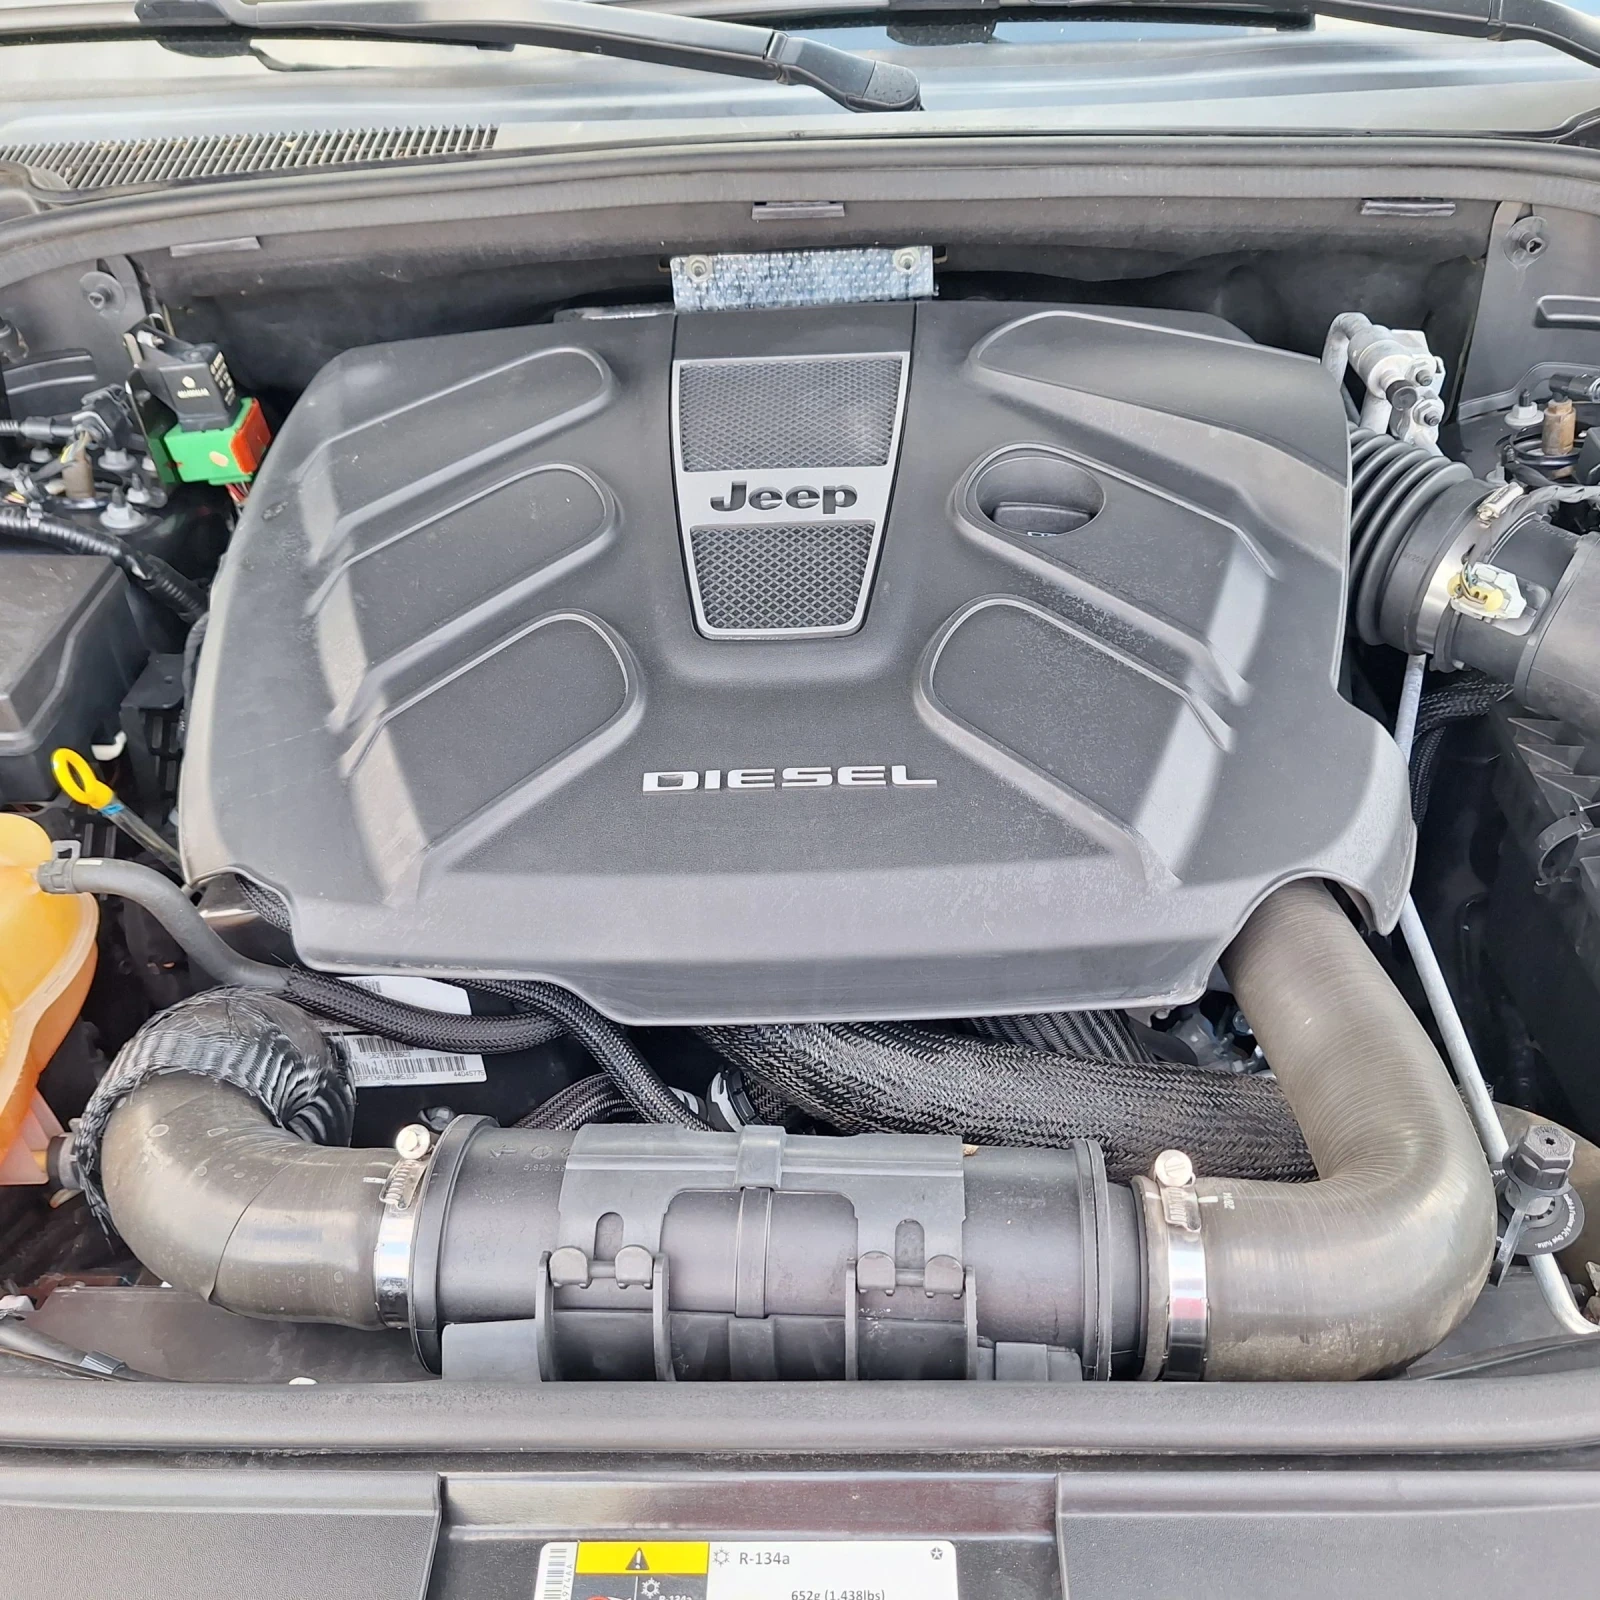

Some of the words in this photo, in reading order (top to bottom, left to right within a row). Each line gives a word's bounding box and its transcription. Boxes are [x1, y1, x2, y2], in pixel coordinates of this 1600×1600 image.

[710, 480, 858, 514] Jeep
[642, 765, 938, 795] DIESEL
[738, 1552, 790, 1565] R-134a
[561, 1563, 573, 1600] 974AA
